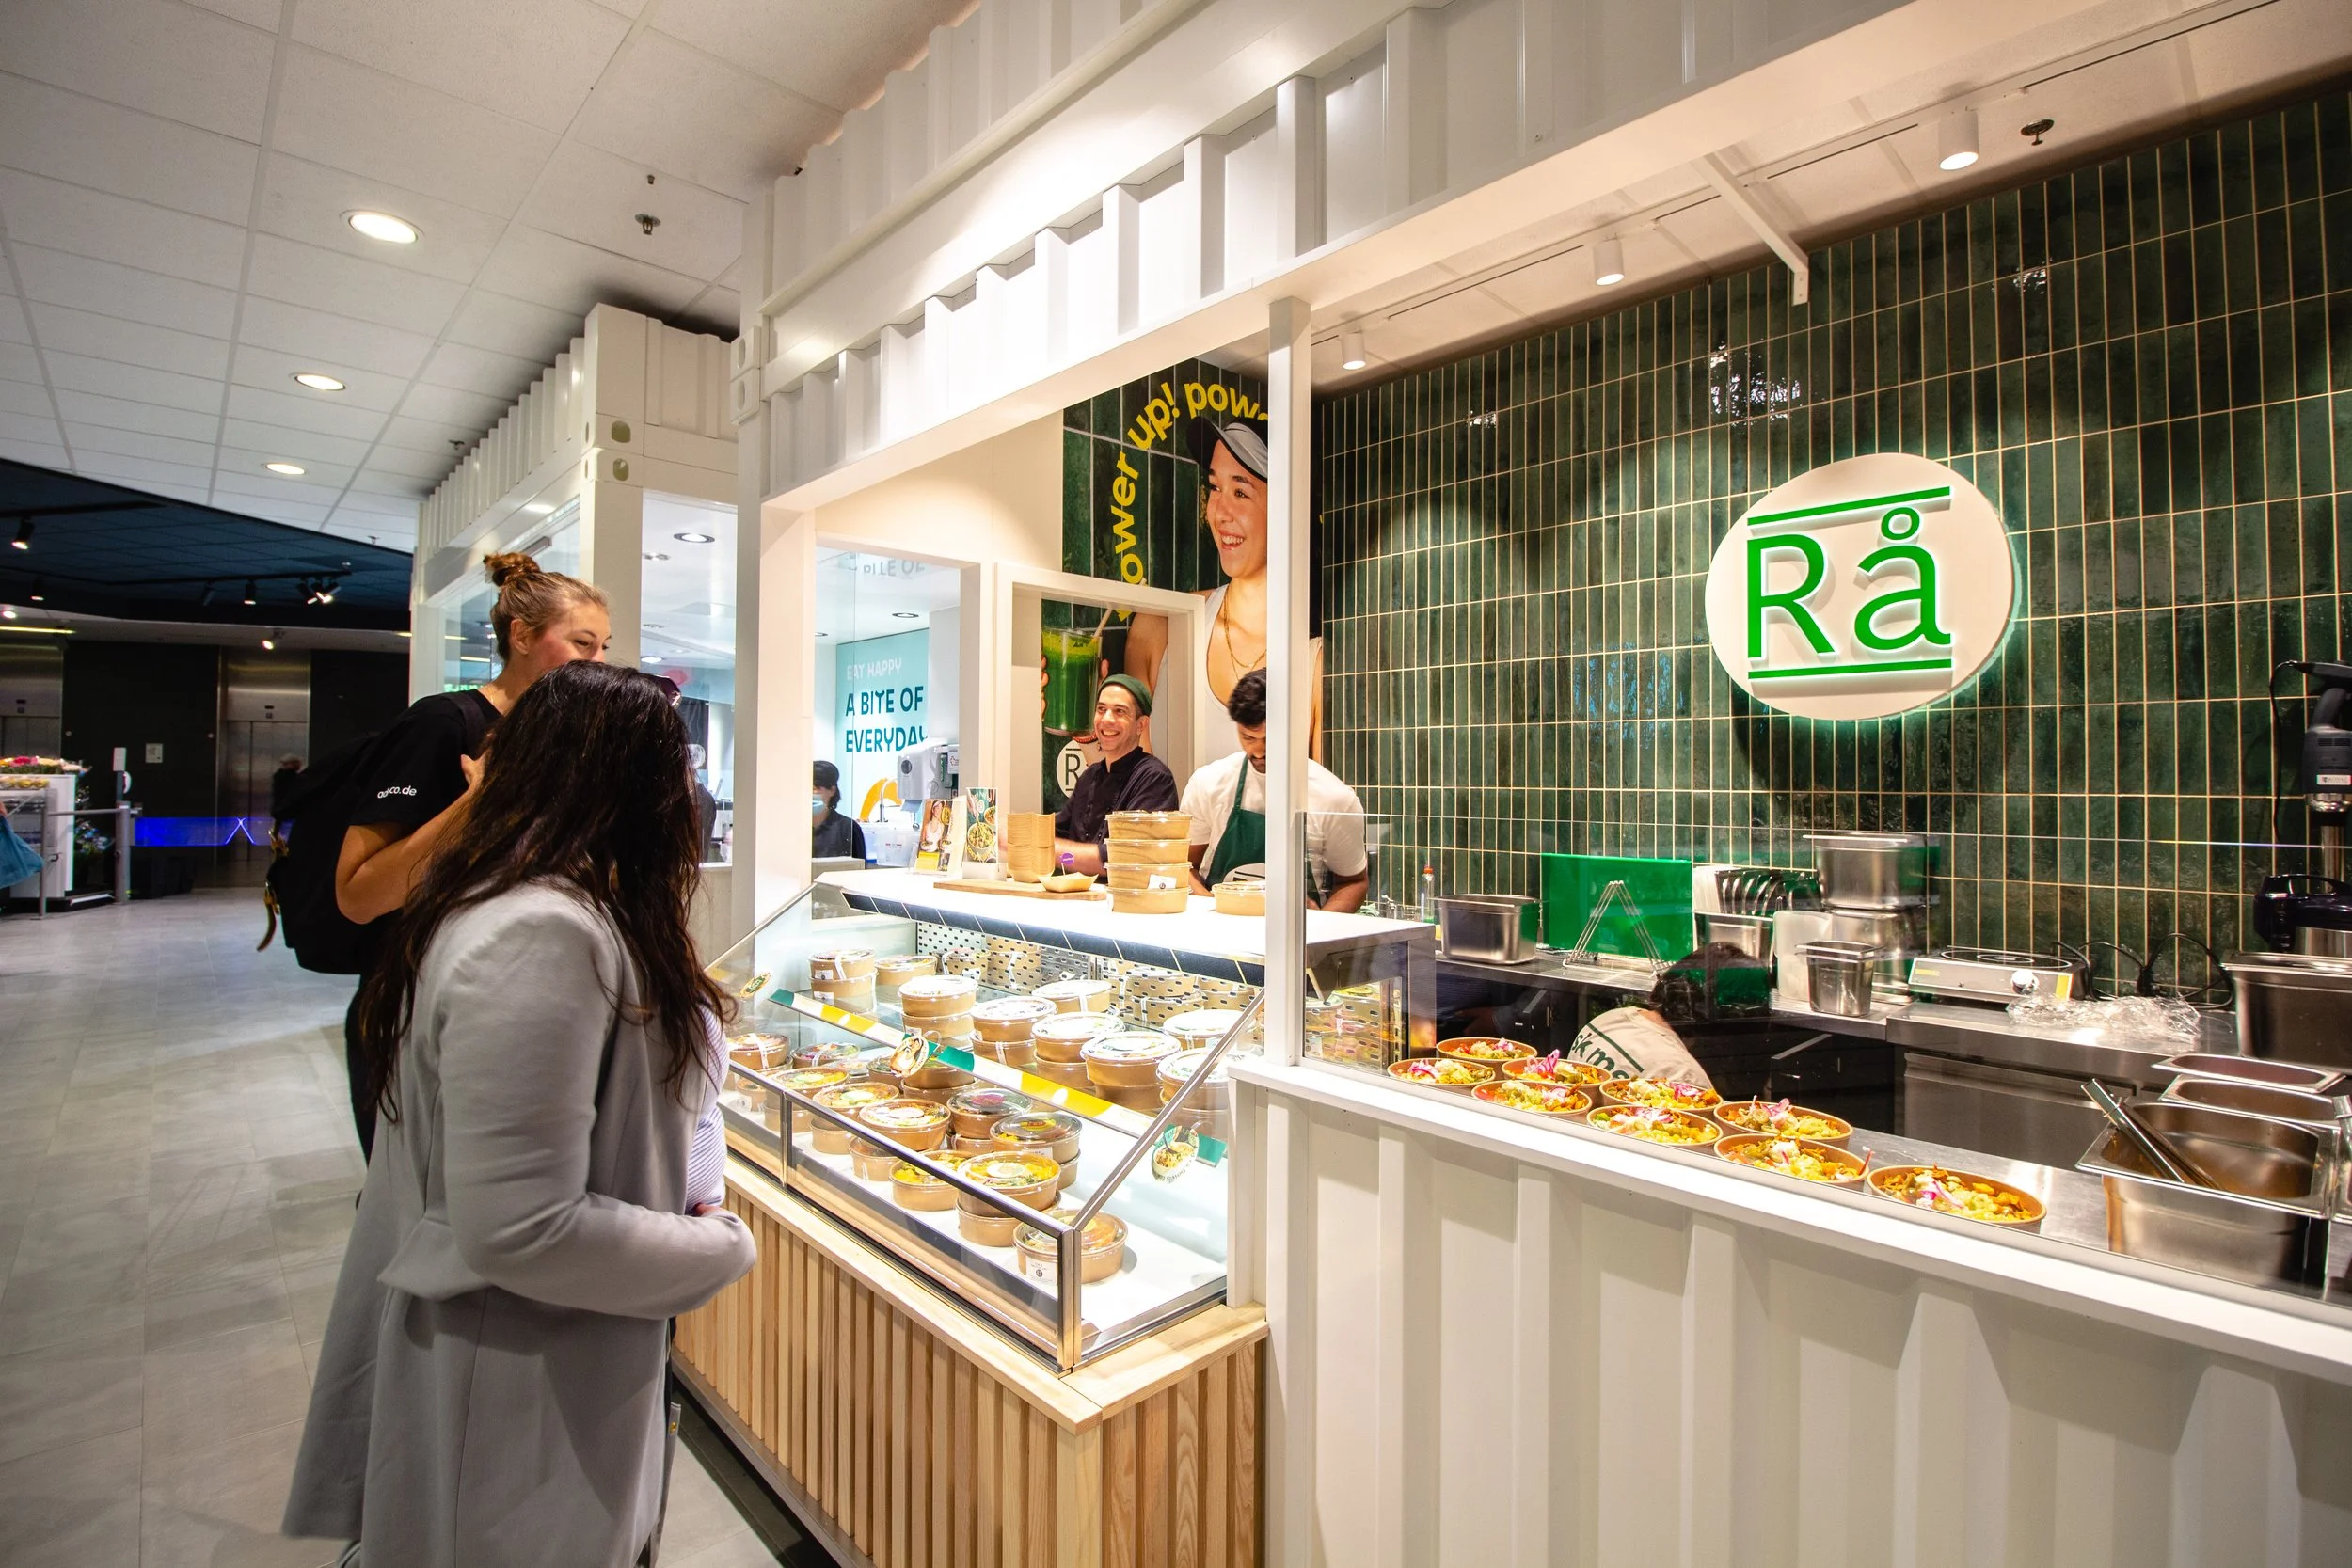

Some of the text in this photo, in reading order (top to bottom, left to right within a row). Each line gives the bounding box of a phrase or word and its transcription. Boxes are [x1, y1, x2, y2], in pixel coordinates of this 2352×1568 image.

[1128, 382, 1181, 451] up!
[1110, 451, 1147, 623] ower
[1746, 506, 1952, 658] Rå
[847, 657, 902, 681] EAT HAPPY
[845, 686, 924, 717] A BITE OF
[1571, 1032, 1593, 1059] sk
